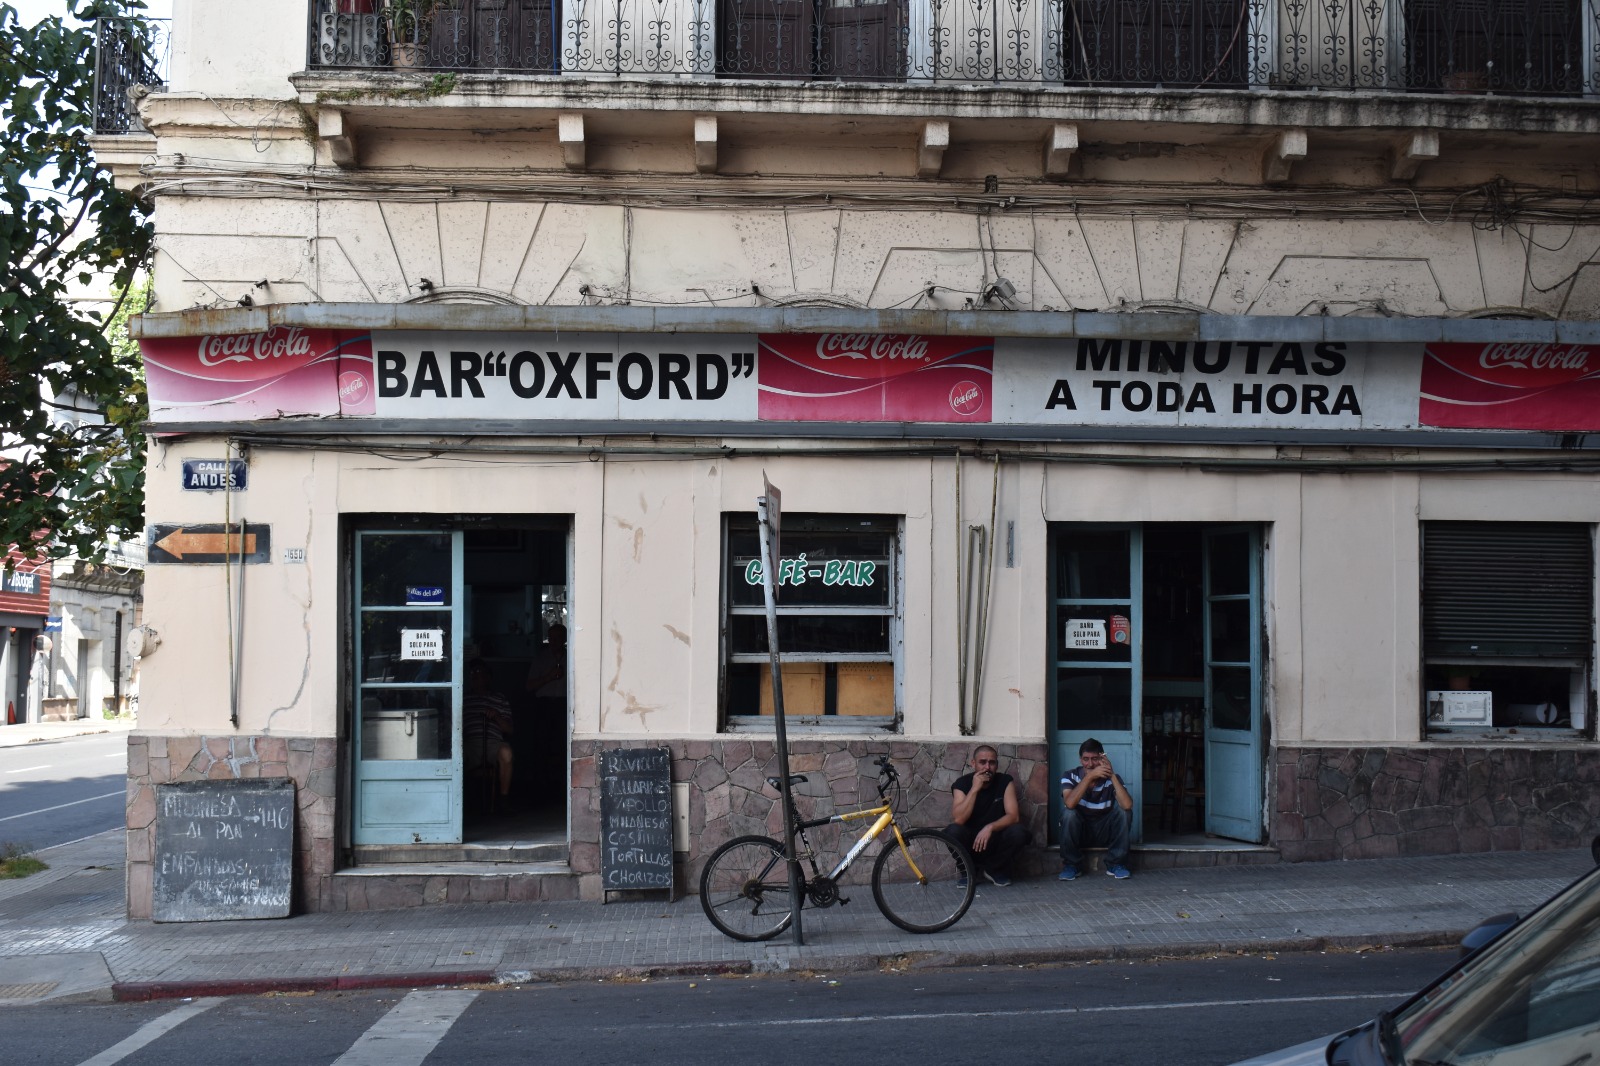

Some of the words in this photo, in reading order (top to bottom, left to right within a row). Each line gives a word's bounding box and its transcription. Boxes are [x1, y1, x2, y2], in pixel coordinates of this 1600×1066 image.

[1075, 339, 1347, 376] MINUTAS
[377, 350, 486, 399] BAR
[1045, 379, 1077, 410] A
[1092, 380, 1216, 413] TODA
[1232, 383, 1363, 415] HORA
[190, 473, 237, 487] ANDES
[745, 553, 876, 587] CFÉ-BAR
[416, 632, 430, 640] BAÑO
[216, 821, 243, 840] PAN
[607, 847, 671, 867] TORTILLAS
[608, 869, 671, 885] CHORIZOS
